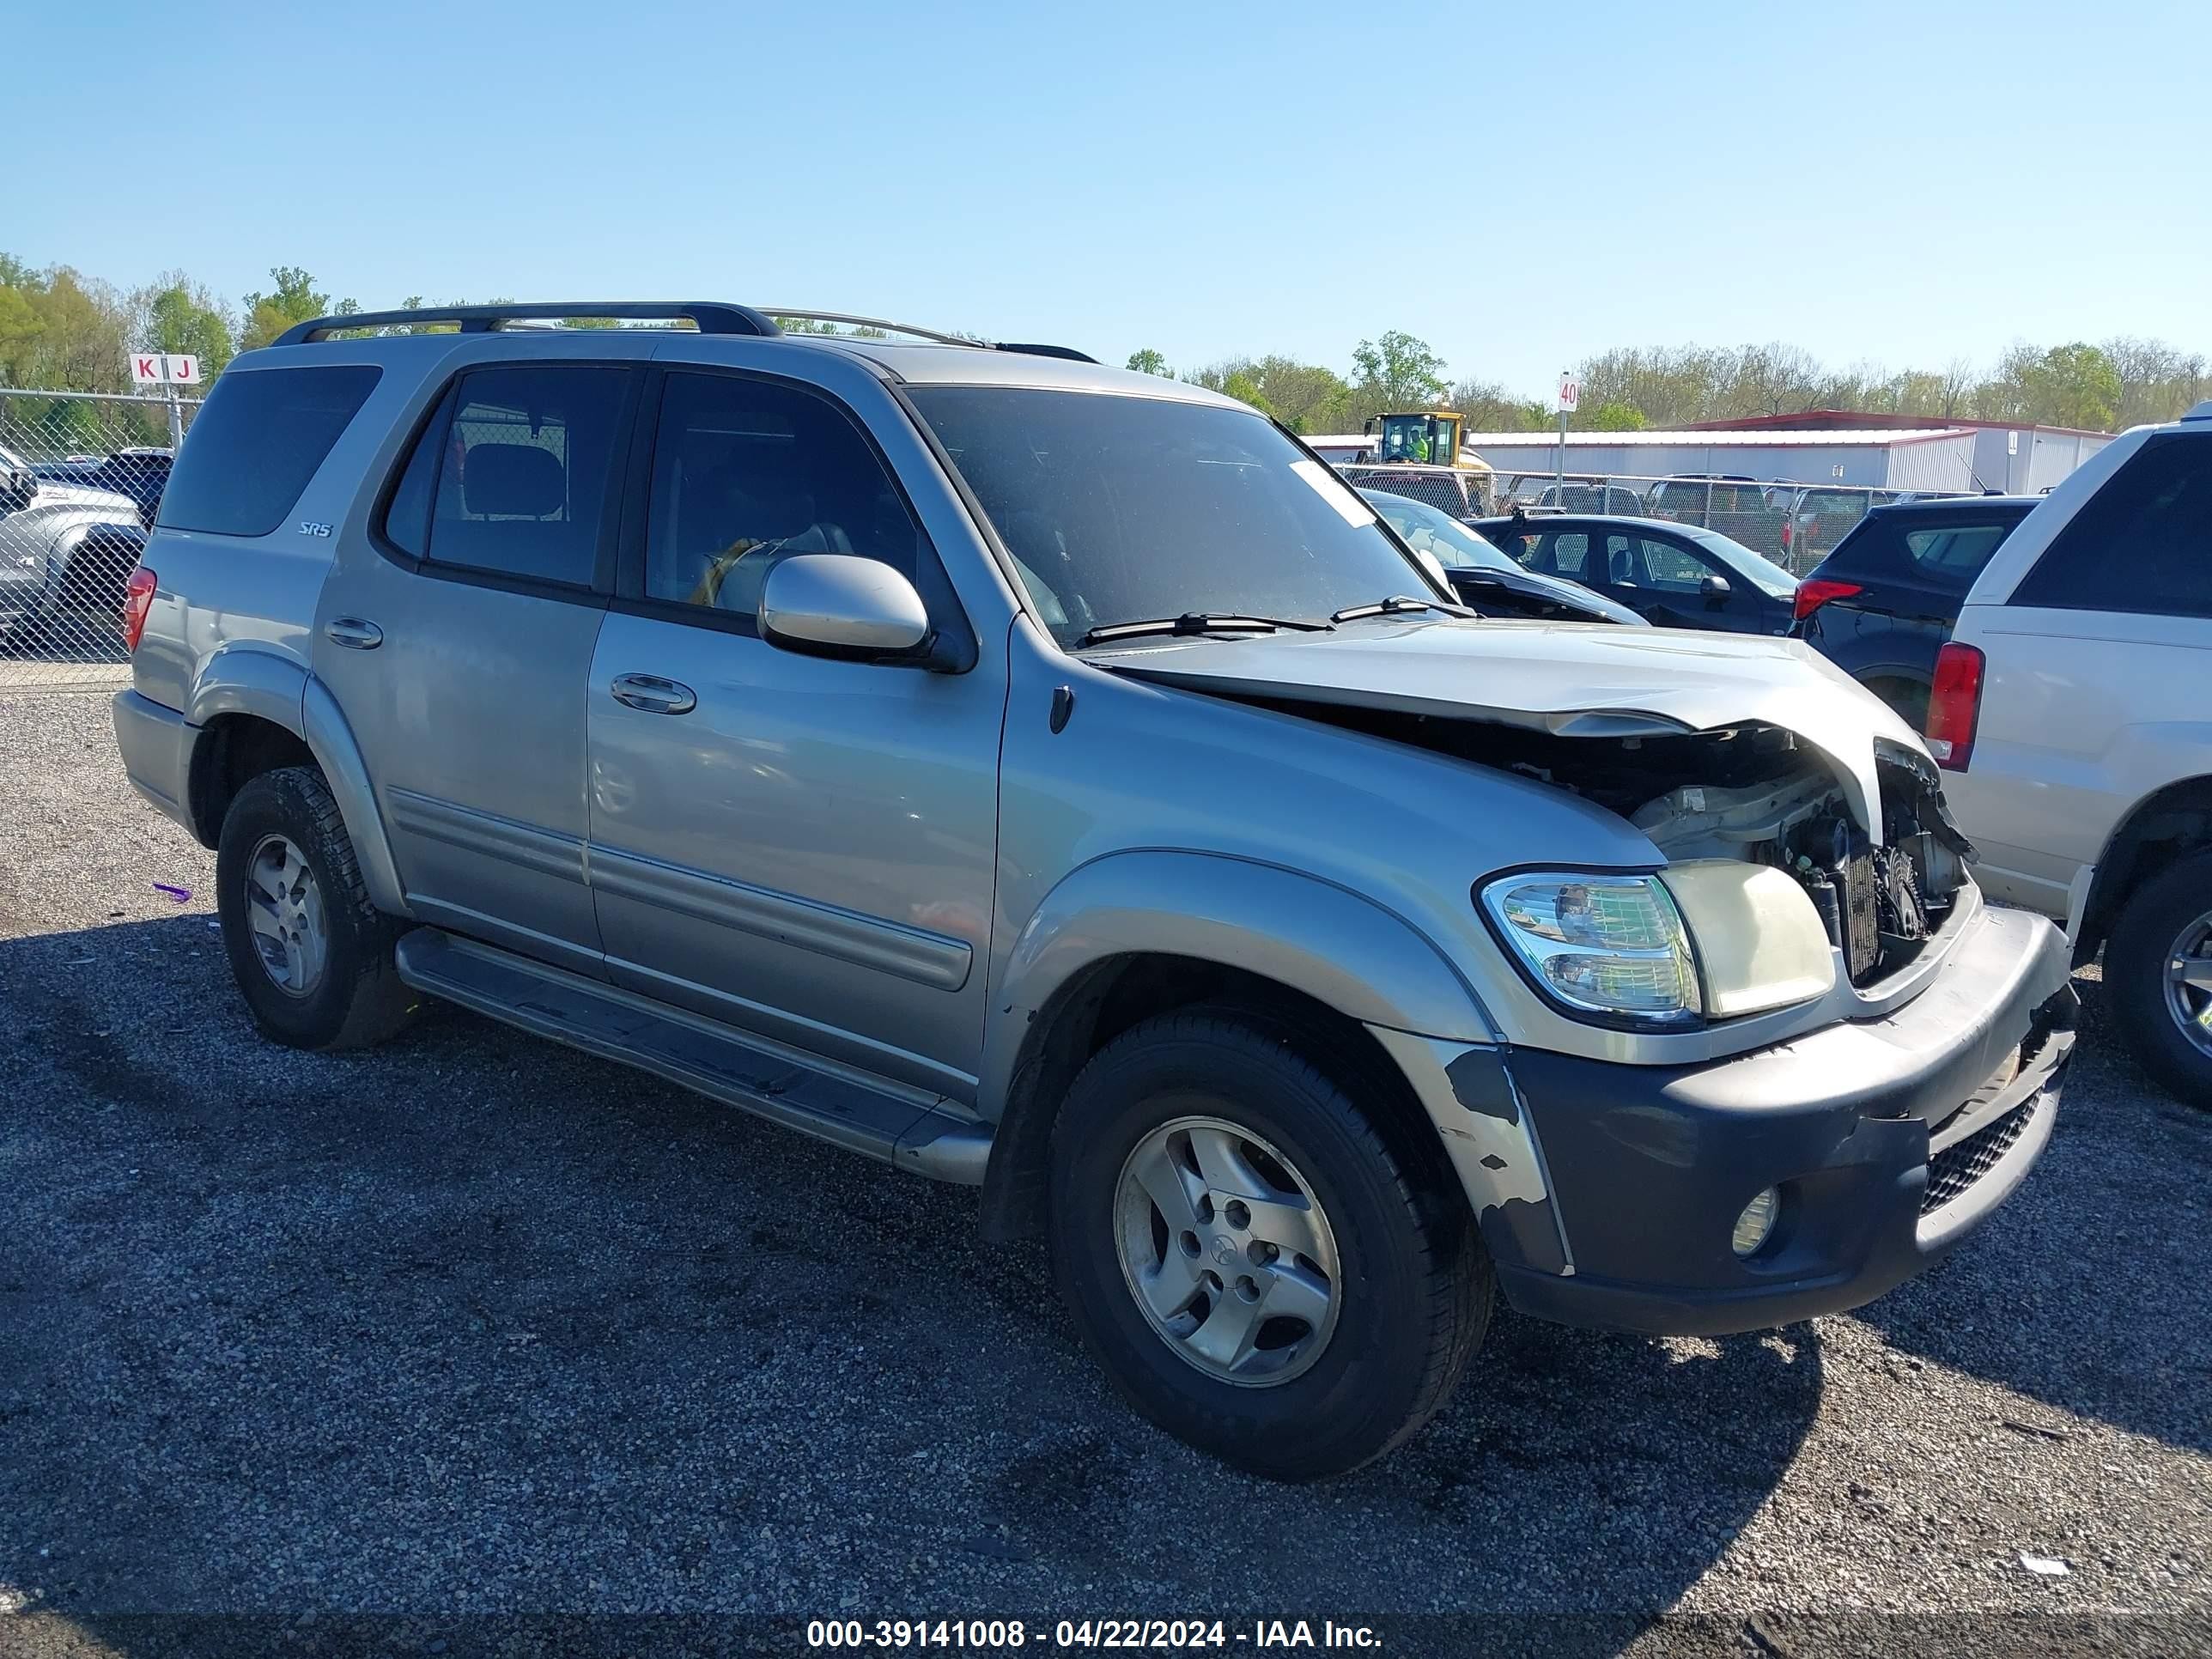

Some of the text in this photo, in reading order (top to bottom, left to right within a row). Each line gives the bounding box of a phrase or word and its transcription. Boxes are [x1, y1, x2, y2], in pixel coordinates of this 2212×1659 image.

[138, 359, 156, 378] K
[177, 359, 190, 379] J
[1561, 383, 1577, 404] 40
[299, 521, 332, 538] SR5
